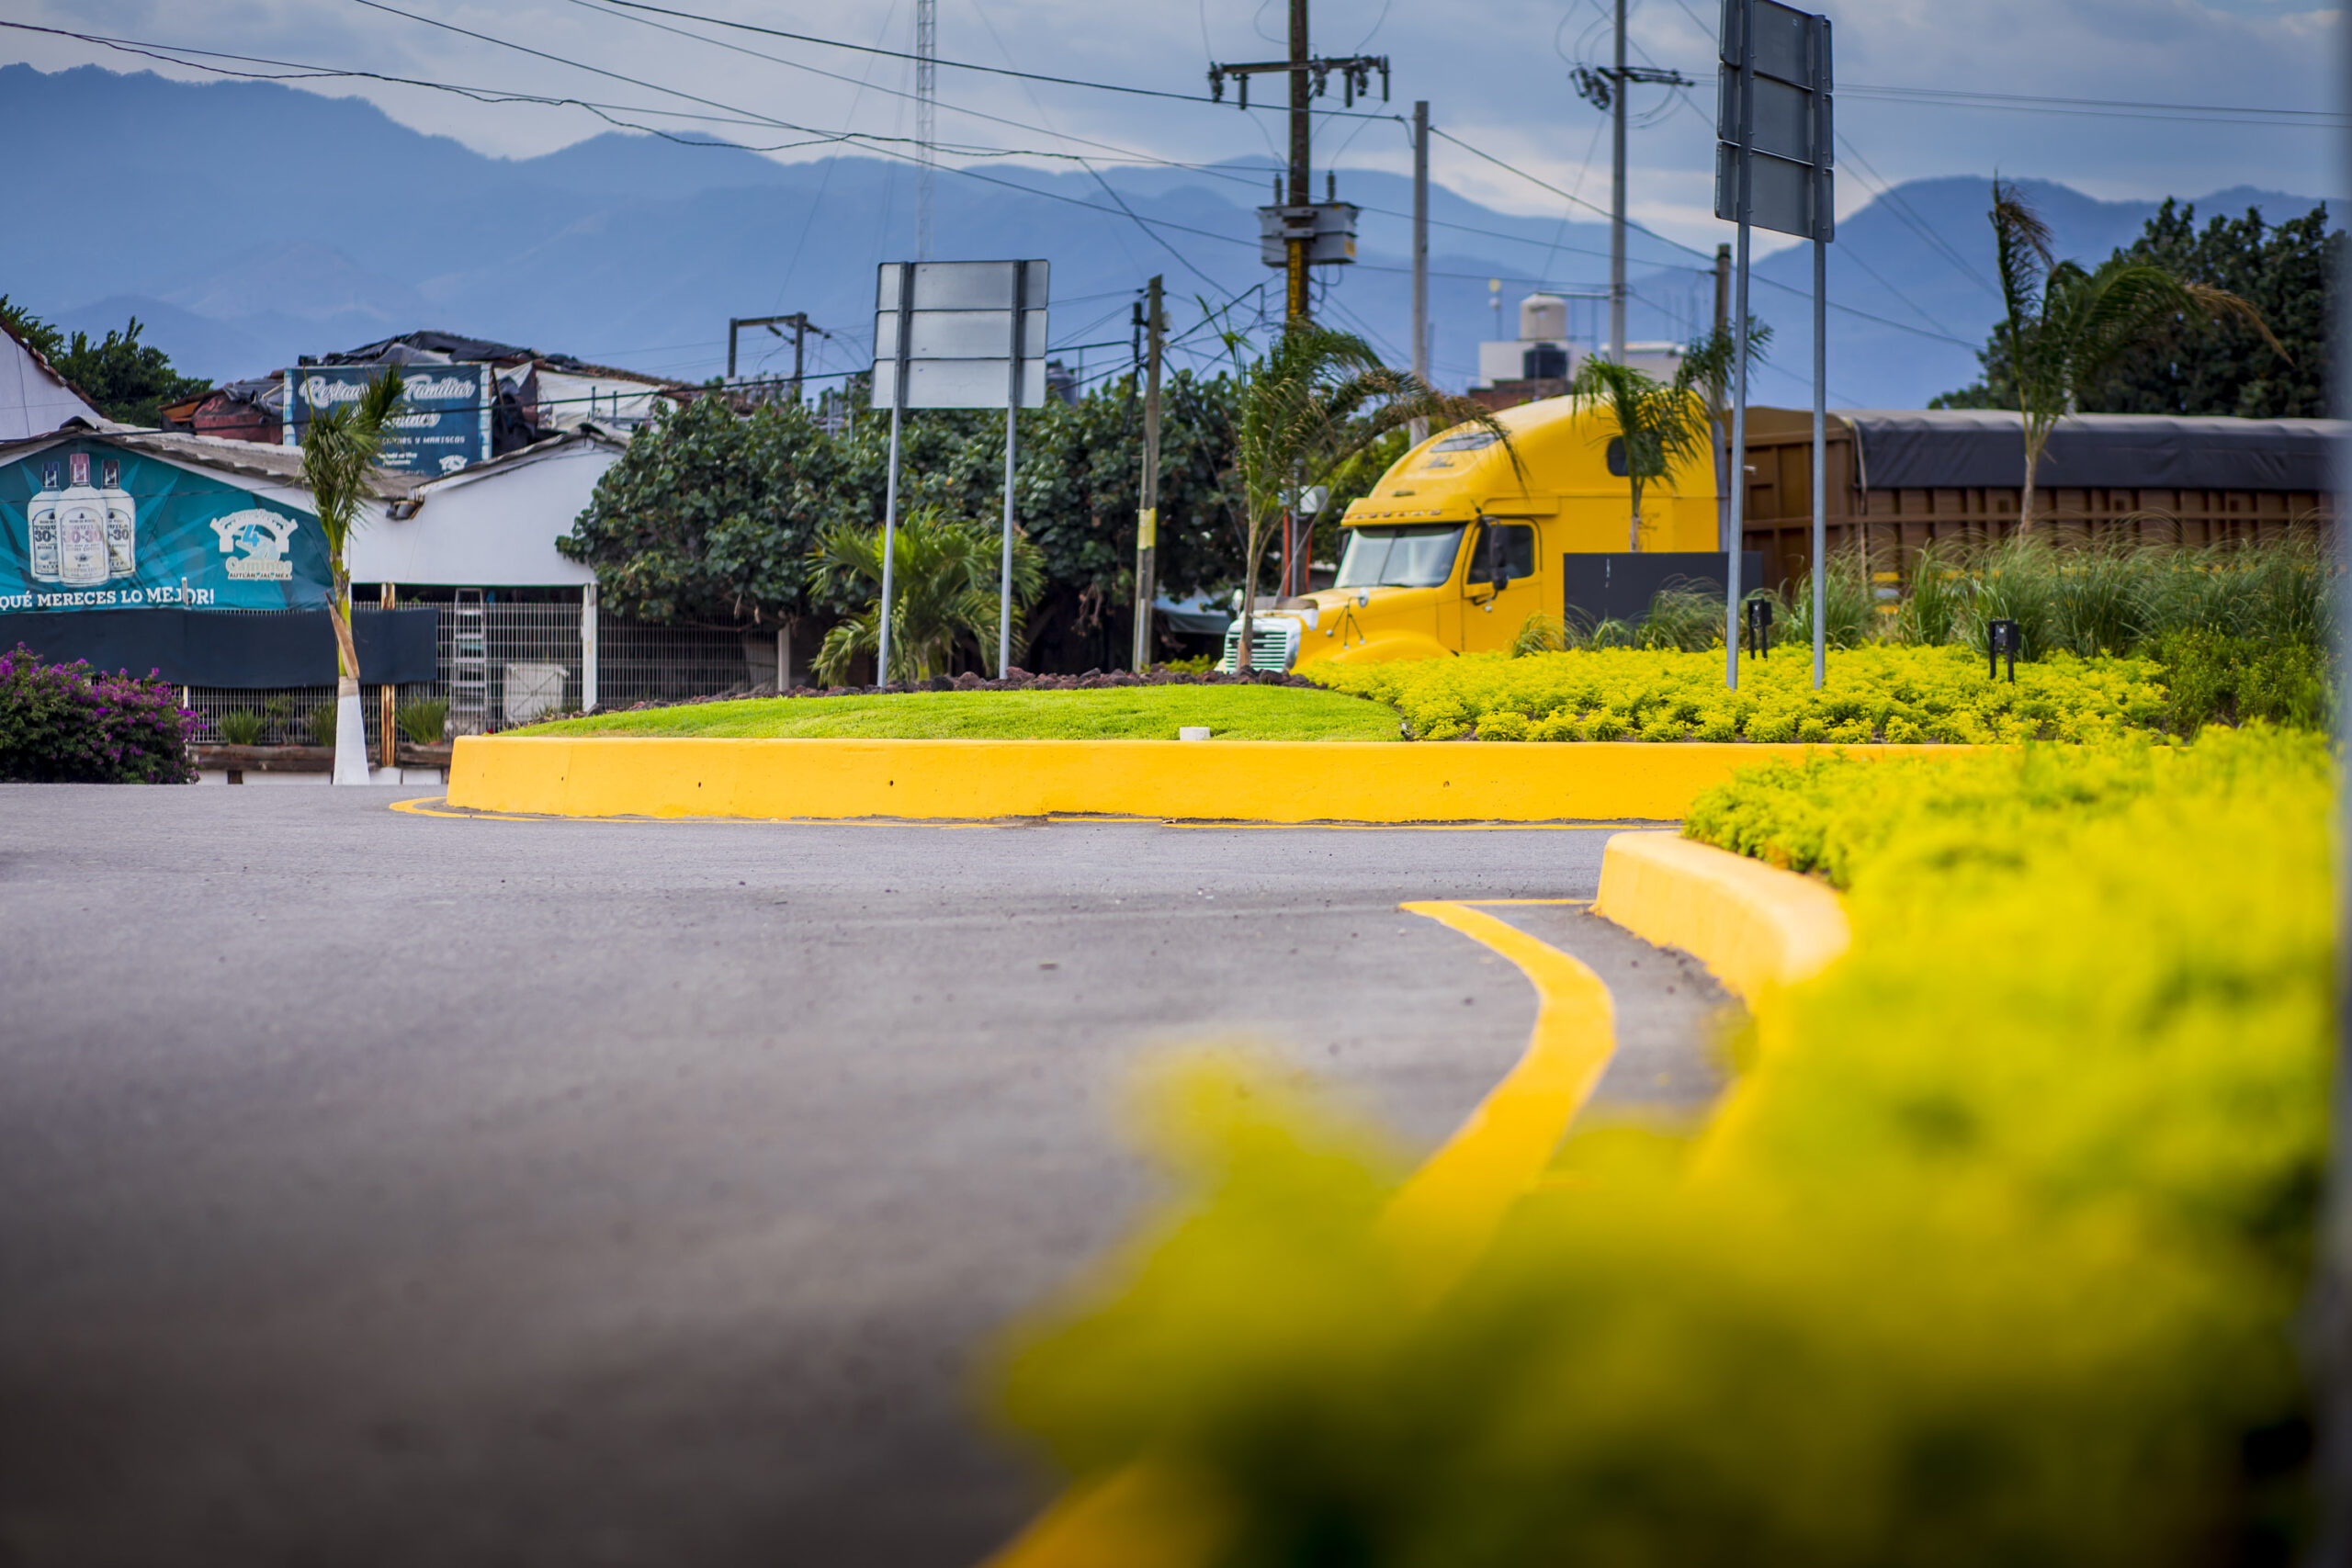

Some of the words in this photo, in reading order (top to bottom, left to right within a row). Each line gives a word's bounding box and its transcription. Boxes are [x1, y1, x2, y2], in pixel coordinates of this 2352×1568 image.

[402, 374, 476, 401] Familiar
[35, 530, 56, 542] 30-
[242, 525, 260, 547] 4
[0, 591, 32, 611] QUÉ
[37, 591, 117, 607] MERECES
[120, 590, 142, 604] LO
